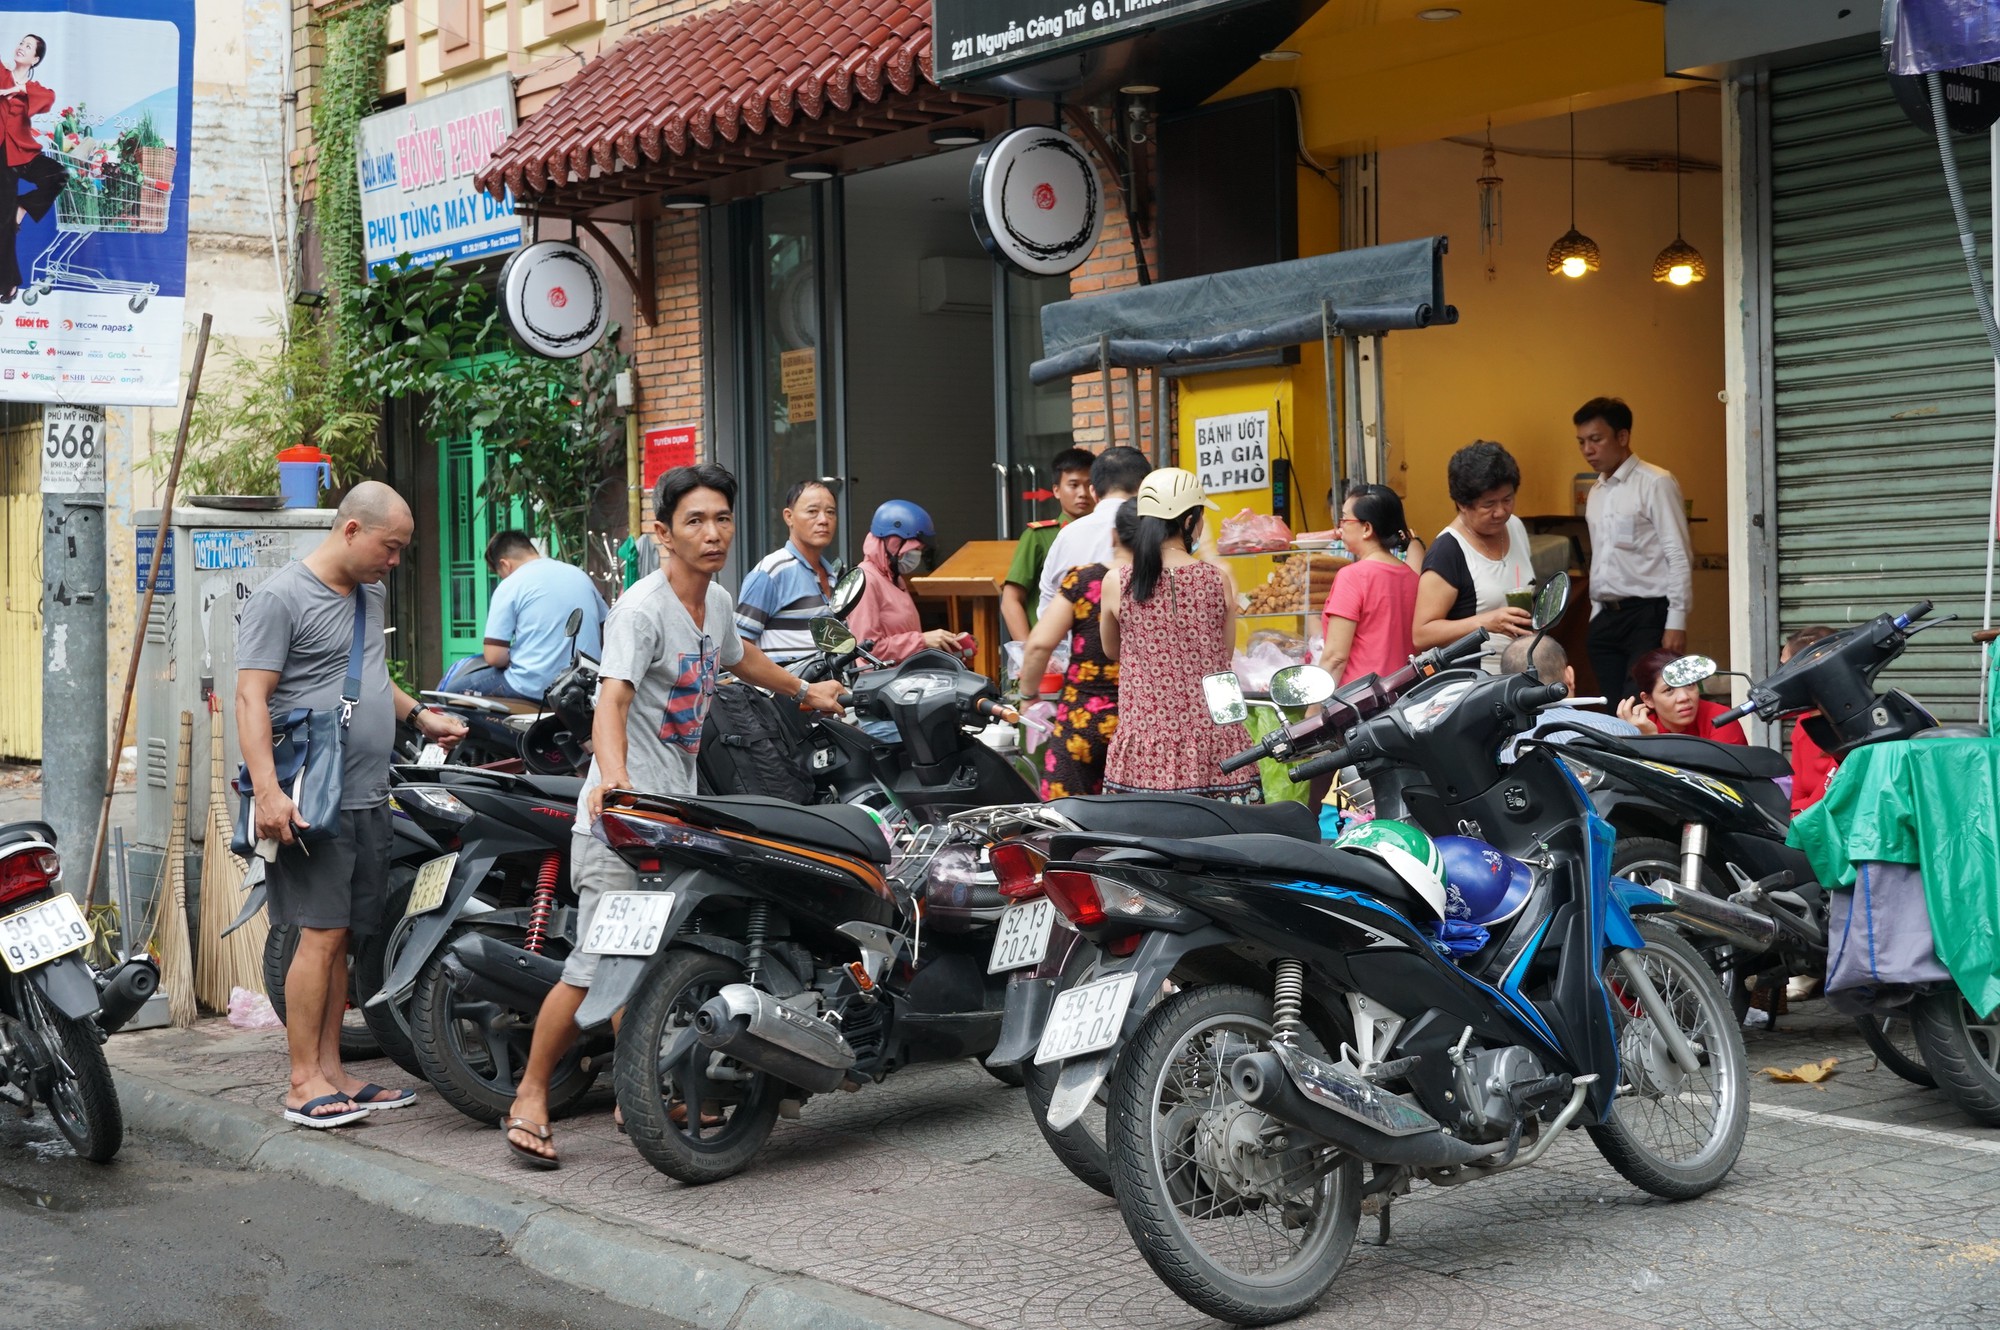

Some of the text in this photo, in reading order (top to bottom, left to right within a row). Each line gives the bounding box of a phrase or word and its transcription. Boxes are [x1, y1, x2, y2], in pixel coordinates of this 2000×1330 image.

[952, 36, 973, 60] 221
[976, 20, 1025, 56] Nguyễn
[1026, 16, 1063, 39] Công
[1065, 6, 1087, 29] Trứ
[1946, 83, 1980, 106] QUẬN 1
[396, 113, 446, 192] HỒNG
[447, 107, 508, 178] PHONG
[368, 216, 397, 252] PHỤ
[400, 202, 441, 240] TÙNG
[445, 189, 478, 231] MÁY
[101, 324, 127, 333] napas
[1, 348, 40, 356] Vietcombank
[31, 373, 56, 381] VPBank
[48, 410, 61, 420] PHÚ
[63, 411, 77, 421] MỸ
[1198, 416, 1265, 446] BÁNH ƯỚT
[46, 423, 95, 459] 568
[1200, 441, 1264, 467] BÀ GIÀ
[4, 903, 65, 941] 59-C1
[9, 921, 87, 966] 939.59
[997, 932, 1039, 967] 2024
[1061, 981, 1121, 1022] 59-C1
[1042, 1013, 1116, 1057] 805.04
